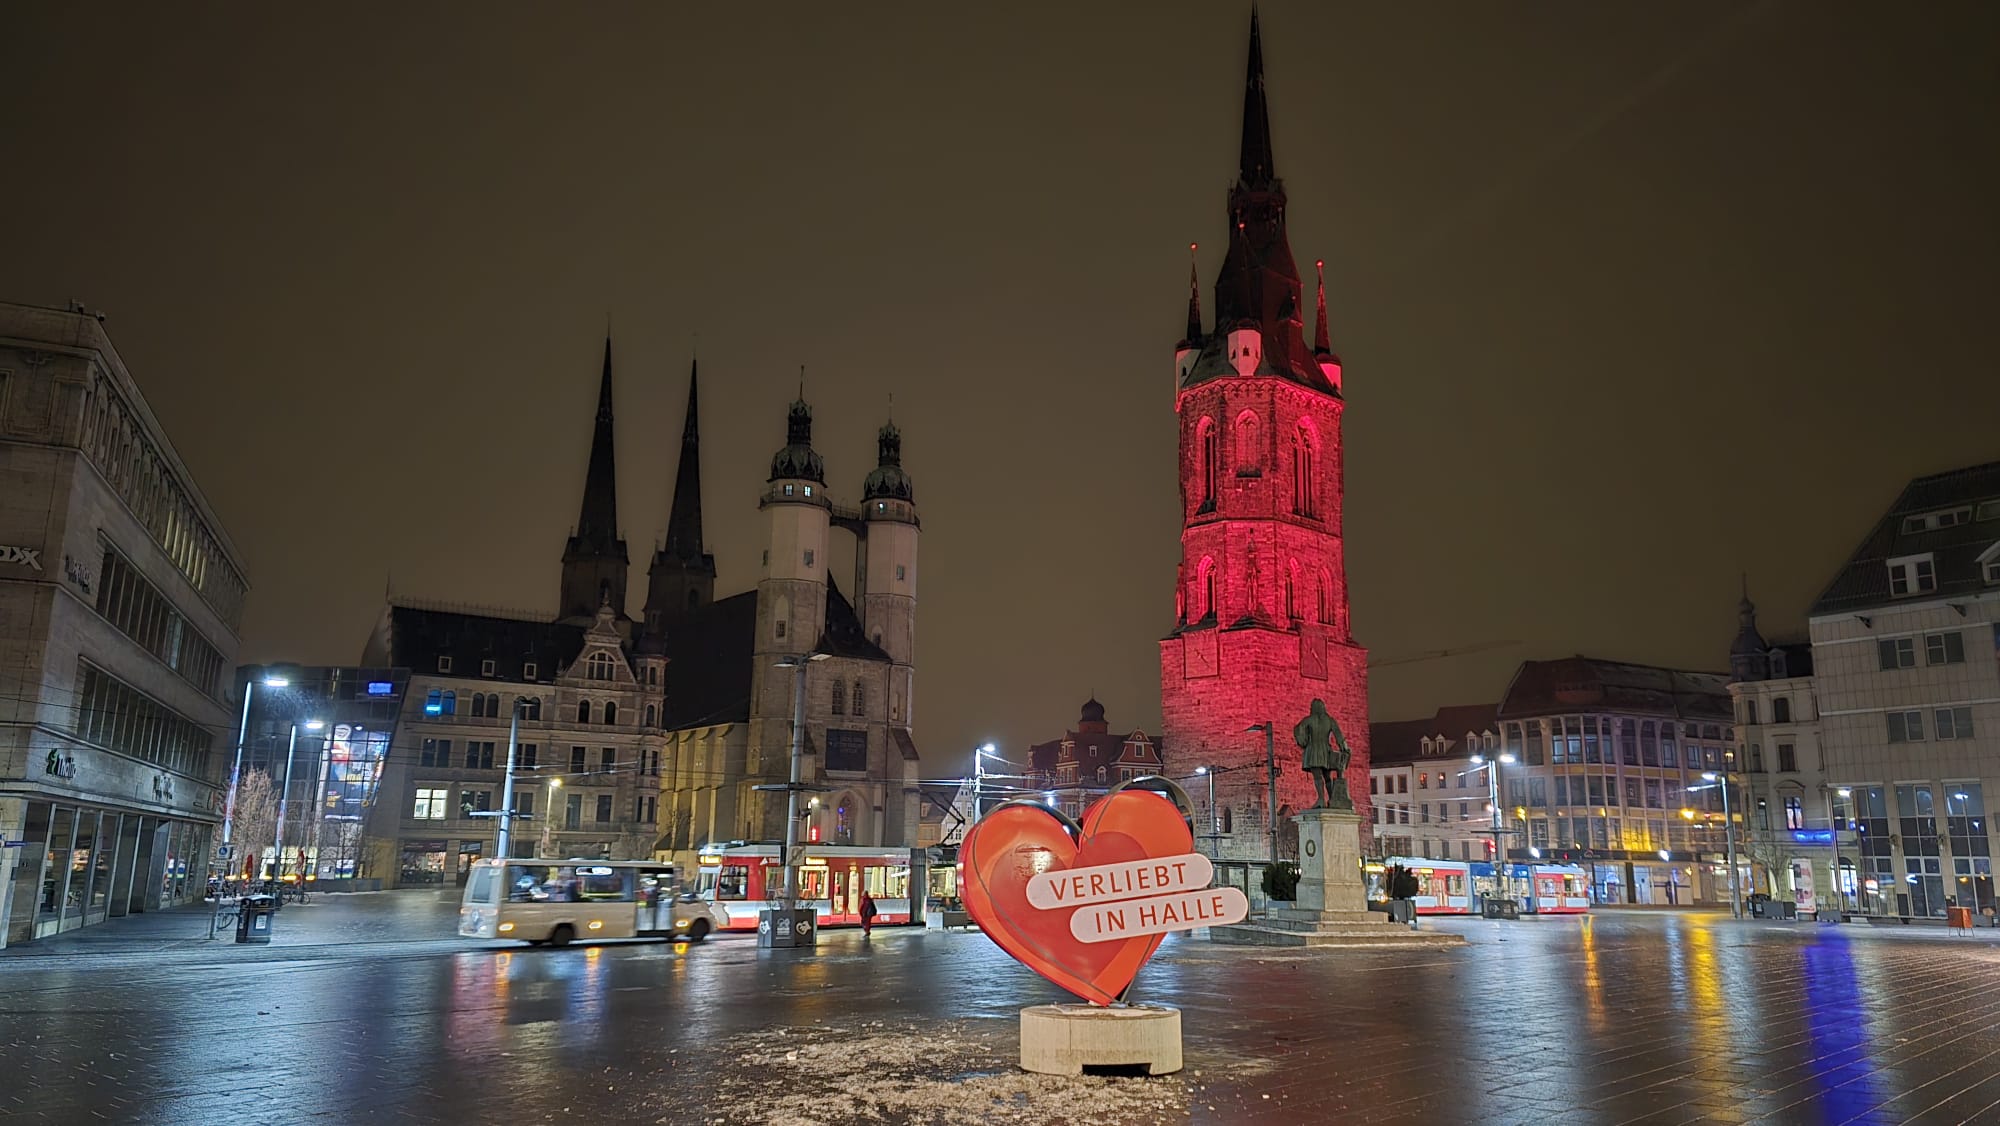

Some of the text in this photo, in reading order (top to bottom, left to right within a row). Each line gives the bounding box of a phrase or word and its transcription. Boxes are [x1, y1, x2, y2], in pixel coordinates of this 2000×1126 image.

[1049, 863, 1185, 900] VERLIEBT
[1095, 896, 1224, 933] IN HALLE
